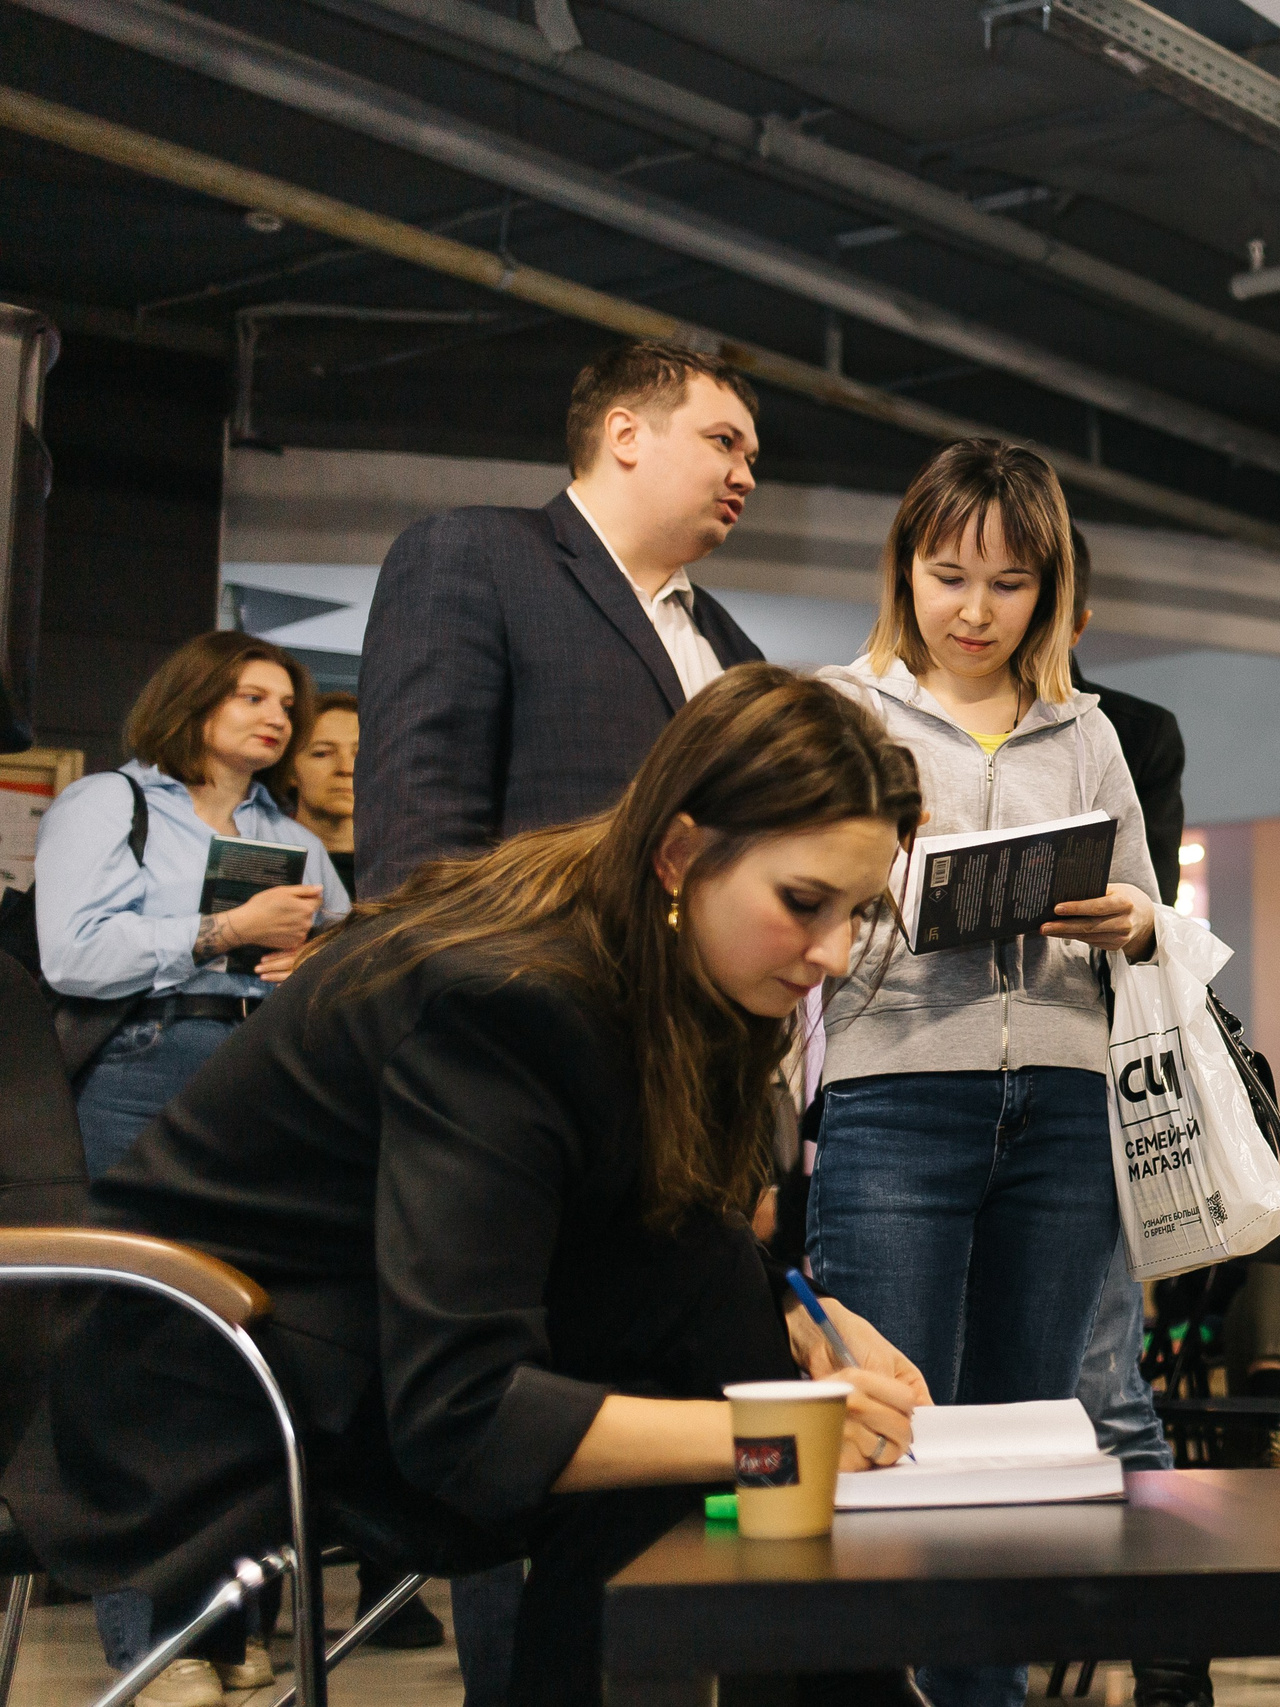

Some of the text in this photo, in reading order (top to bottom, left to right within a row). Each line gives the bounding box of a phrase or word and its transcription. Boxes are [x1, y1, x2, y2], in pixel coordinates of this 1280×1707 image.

[1128, 1148, 1192, 1182] МАГАЗИ
[1142, 1213, 1173, 1229] УЗНАЙТЕ
[1144, 1223, 1176, 1238] О БРЕНДЕ
